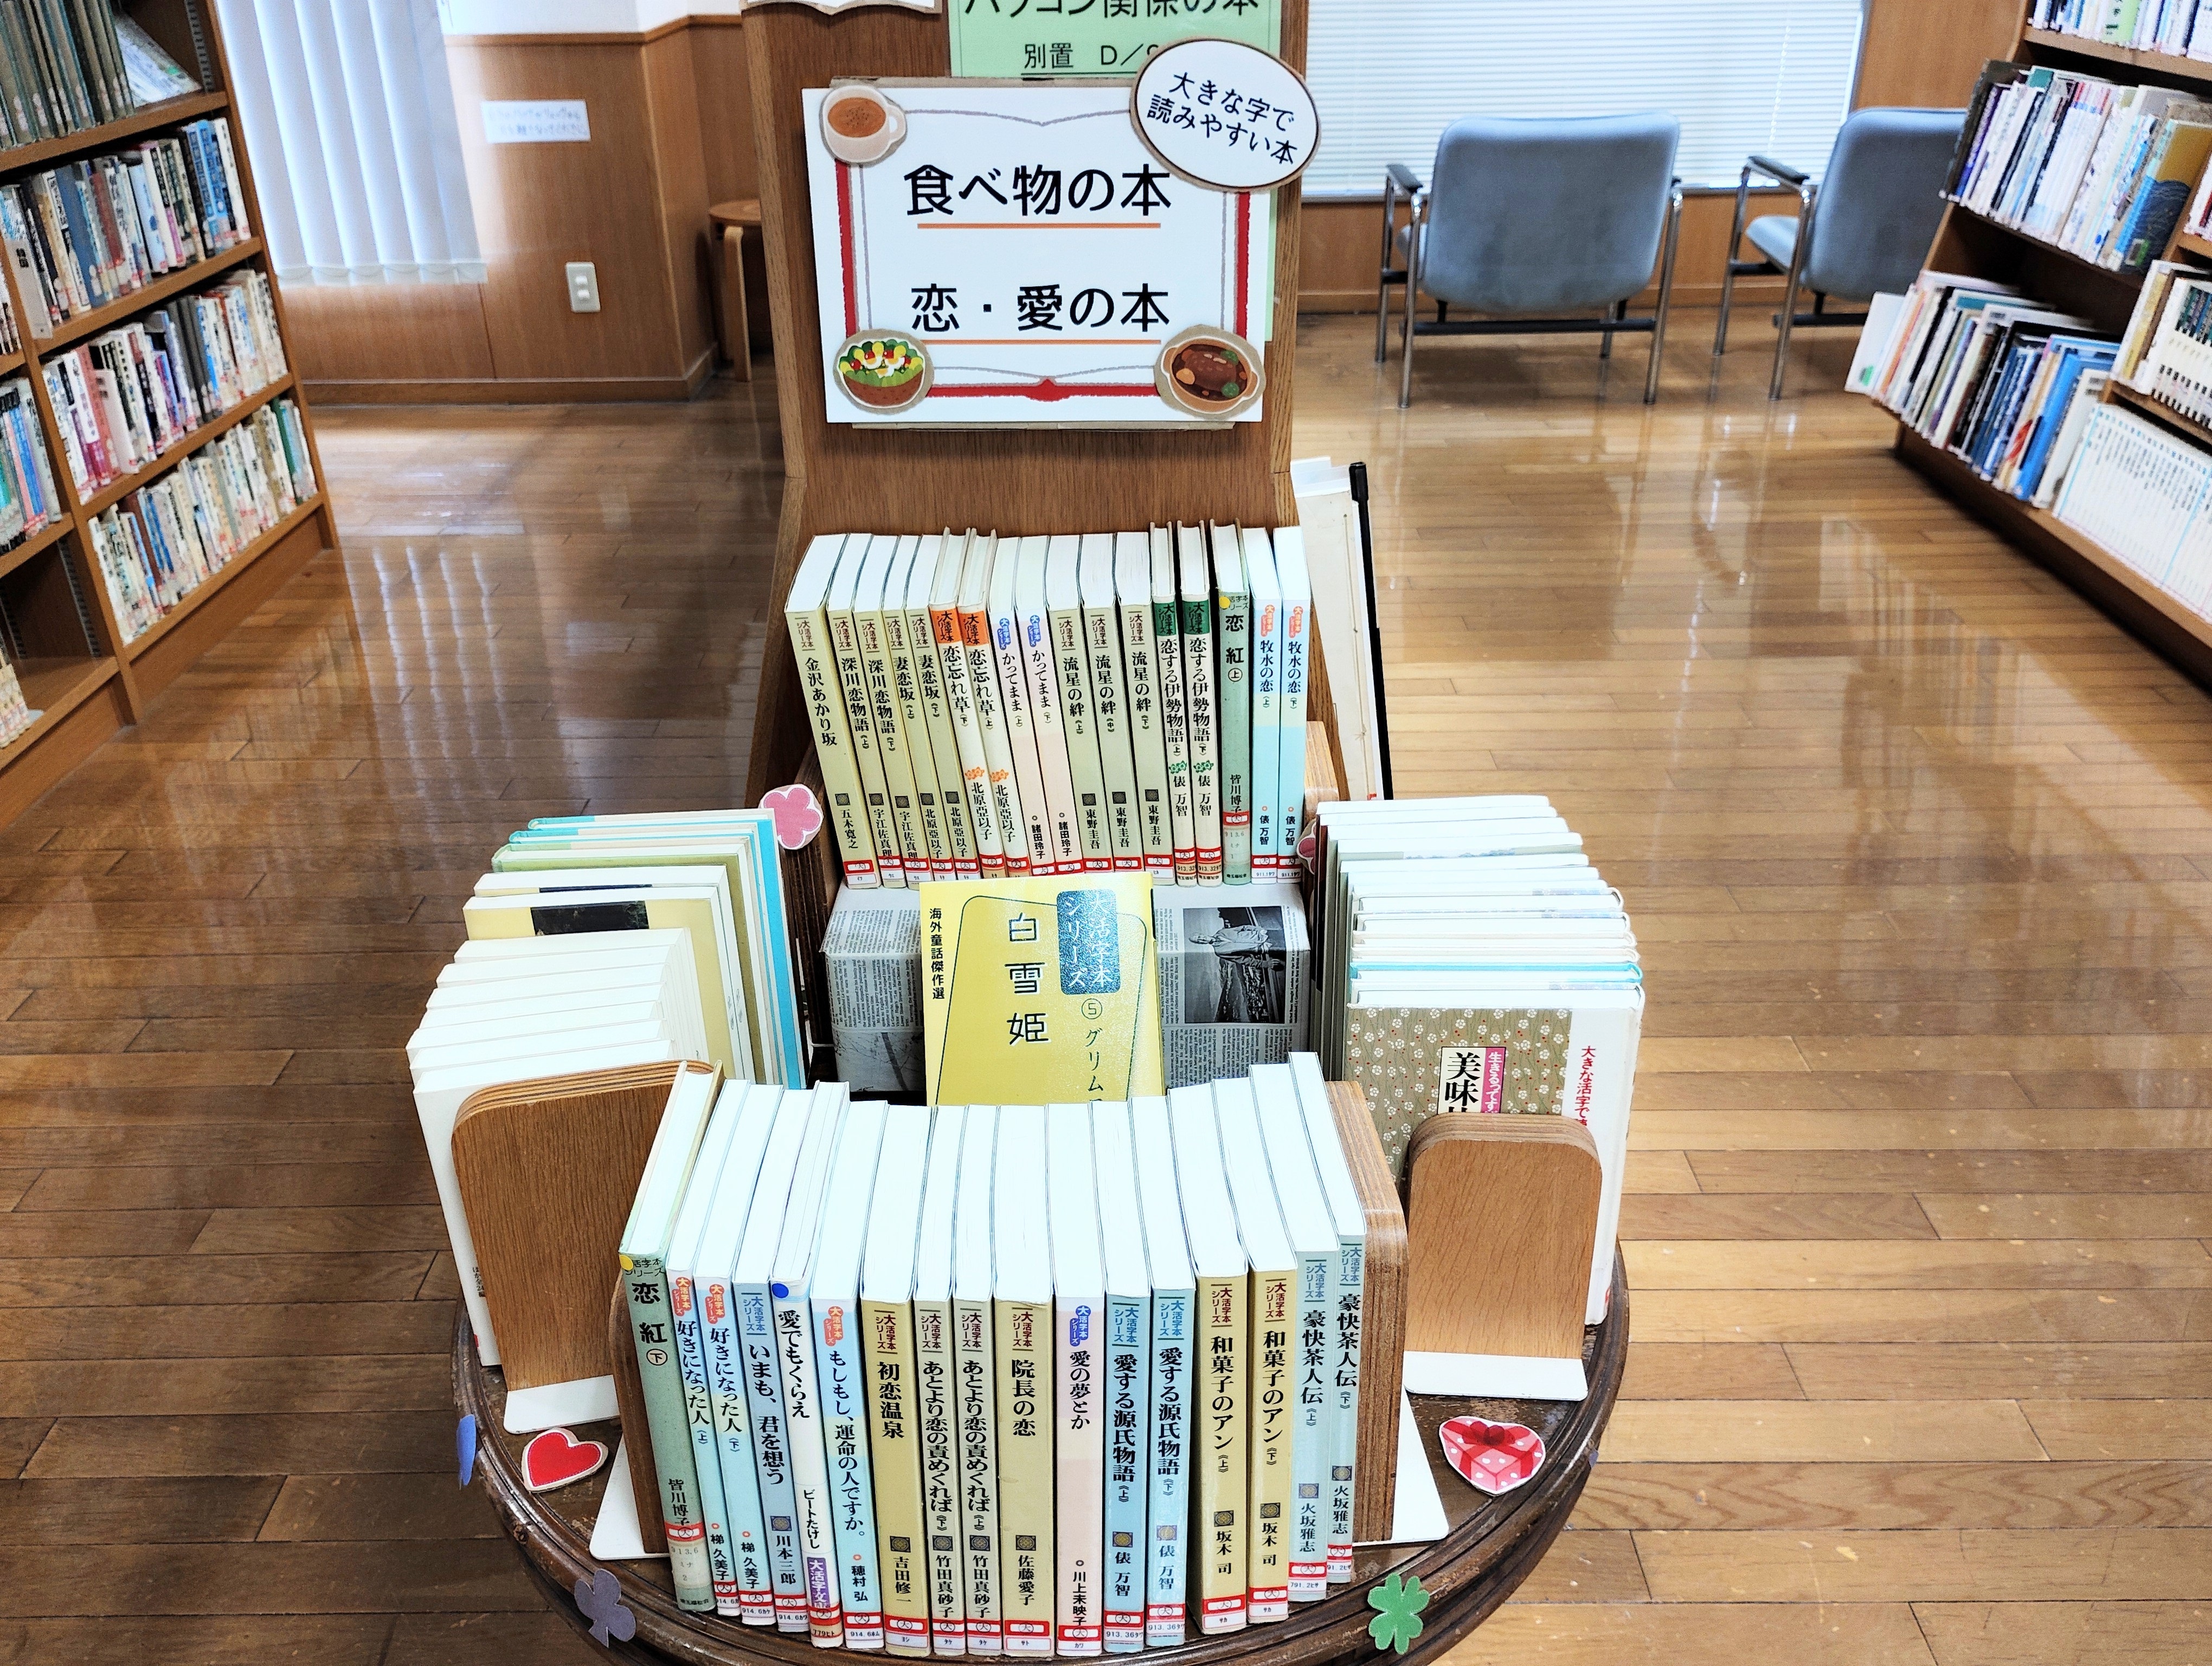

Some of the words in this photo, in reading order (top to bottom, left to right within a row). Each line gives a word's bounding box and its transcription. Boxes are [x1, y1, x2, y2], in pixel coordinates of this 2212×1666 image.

[1024, 42, 1074, 69] 別置
[1168, 71, 1295, 133] 大きな字で
[1147, 94, 1298, 165] 読みやすい本
[903, 164, 1172, 217] 食べ物の本
[911, 284, 1170, 333] 恋・愛の本
[796, 623, 807, 648] シリーズ
[803, 621, 815, 648] 大活字本
[1131, 614, 1144, 644] 大活字本
[1158, 607, 1167, 636] シリーズ
[1164, 603, 1175, 636] 大活字本
[1225, 615, 1244, 665] 恋紅
[805, 658, 837, 746] 金沢あかり坂
[970, 783, 992, 841] 北原亞以子
[995, 784, 1016, 843] 北原亞以子
[1230, 774, 1242, 813] 皆川博子
[841, 809, 858, 849] 五木寛之
[873, 809, 892, 856] 宇江佐真理
[899, 811, 917, 858] 宇江佐真理
[925, 809, 942, 858] 北原亞以子
[950, 806, 968, 857] 北原亞以子
[1032, 825, 1045, 859] 諸田玲子
[1059, 821, 1072, 857] 諸田玲子
[1085, 809, 1100, 850] 東野圭吾
[1116, 807, 1130, 848] 東野圭吾
[1148, 805, 1161, 846] 東野圭吾
[929, 908, 945, 999] 海外童話傑作選
[1066, 895, 1086, 988] シリーズ
[1089, 893, 1112, 988] 大活字本
[1005, 912, 1049, 1045] 白雪姫
[1084, 1028, 1104, 1101] グリム
[1484, 1052, 1502, 1113] 生きるってす
[633, 1257, 662, 1267] 活字本
[1305, 1266, 1314, 1298] シリーズ
[1315, 1263, 1326, 1298] 大活字本
[1340, 1250, 1349, 1281] シリーズ
[1350, 1247, 1362, 1281] 大活字本
[632, 1283, 668, 1344] 恋紅
[1160, 1303, 1170, 1336] シリーズ
[1171, 1300, 1184, 1336] 大活字本
[1212, 1291, 1220, 1323] シリーズ
[1220, 1287, 1232, 1323] 大活字本
[1266, 1286, 1274, 1317] シリーズ
[1275, 1283, 1286, 1317] 大活字本
[876, 1317, 886, 1349] シリーズ
[885, 1315, 897, 1350] 大活字本
[921, 1316, 931, 1348] シリーズ
[929, 1313, 942, 1349] 大活字本
[961, 1315, 972, 1348] シリーズ
[970, 1313, 982, 1348] 大活字本
[1013, 1313, 1022, 1346] シリーズ
[1022, 1312, 1033, 1347] 大活字本
[1078, 1306, 1089, 1339] 大活字本
[1114, 1309, 1124, 1342] シリーズ
[1126, 1307, 1139, 1342] 大活字本
[779, 1310, 810, 1419] 愛でもくらえ
[877, 1362, 904, 1438] 初恋温泉
[1012, 1359, 1036, 1437] 院長の恋
[1070, 1351, 1091, 1430] 愛の夢とか
[749, 1344, 785, 1484] いまも、君を想う
[829, 1351, 865, 1536] もしもし、運命の人ですか。
[668, 1478, 690, 1526] 皆川博子
[803, 1489, 820, 1549] ビートたけし
[1332, 1485, 1349, 1534] 火坂雅志
[1300, 1503, 1316, 1553] 火坂雅志
[776, 1535, 796, 1585] 川本三郎
[893, 1556, 911, 1602] 吉田修一
[1018, 1555, 1035, 1606] 佐藤愛子
[936, 1555, 954, 1618] 竹田真砂子
[973, 1555, 991, 1618] 竹田真砂子
[1073, 1572, 1086, 1625] 川上未映子
